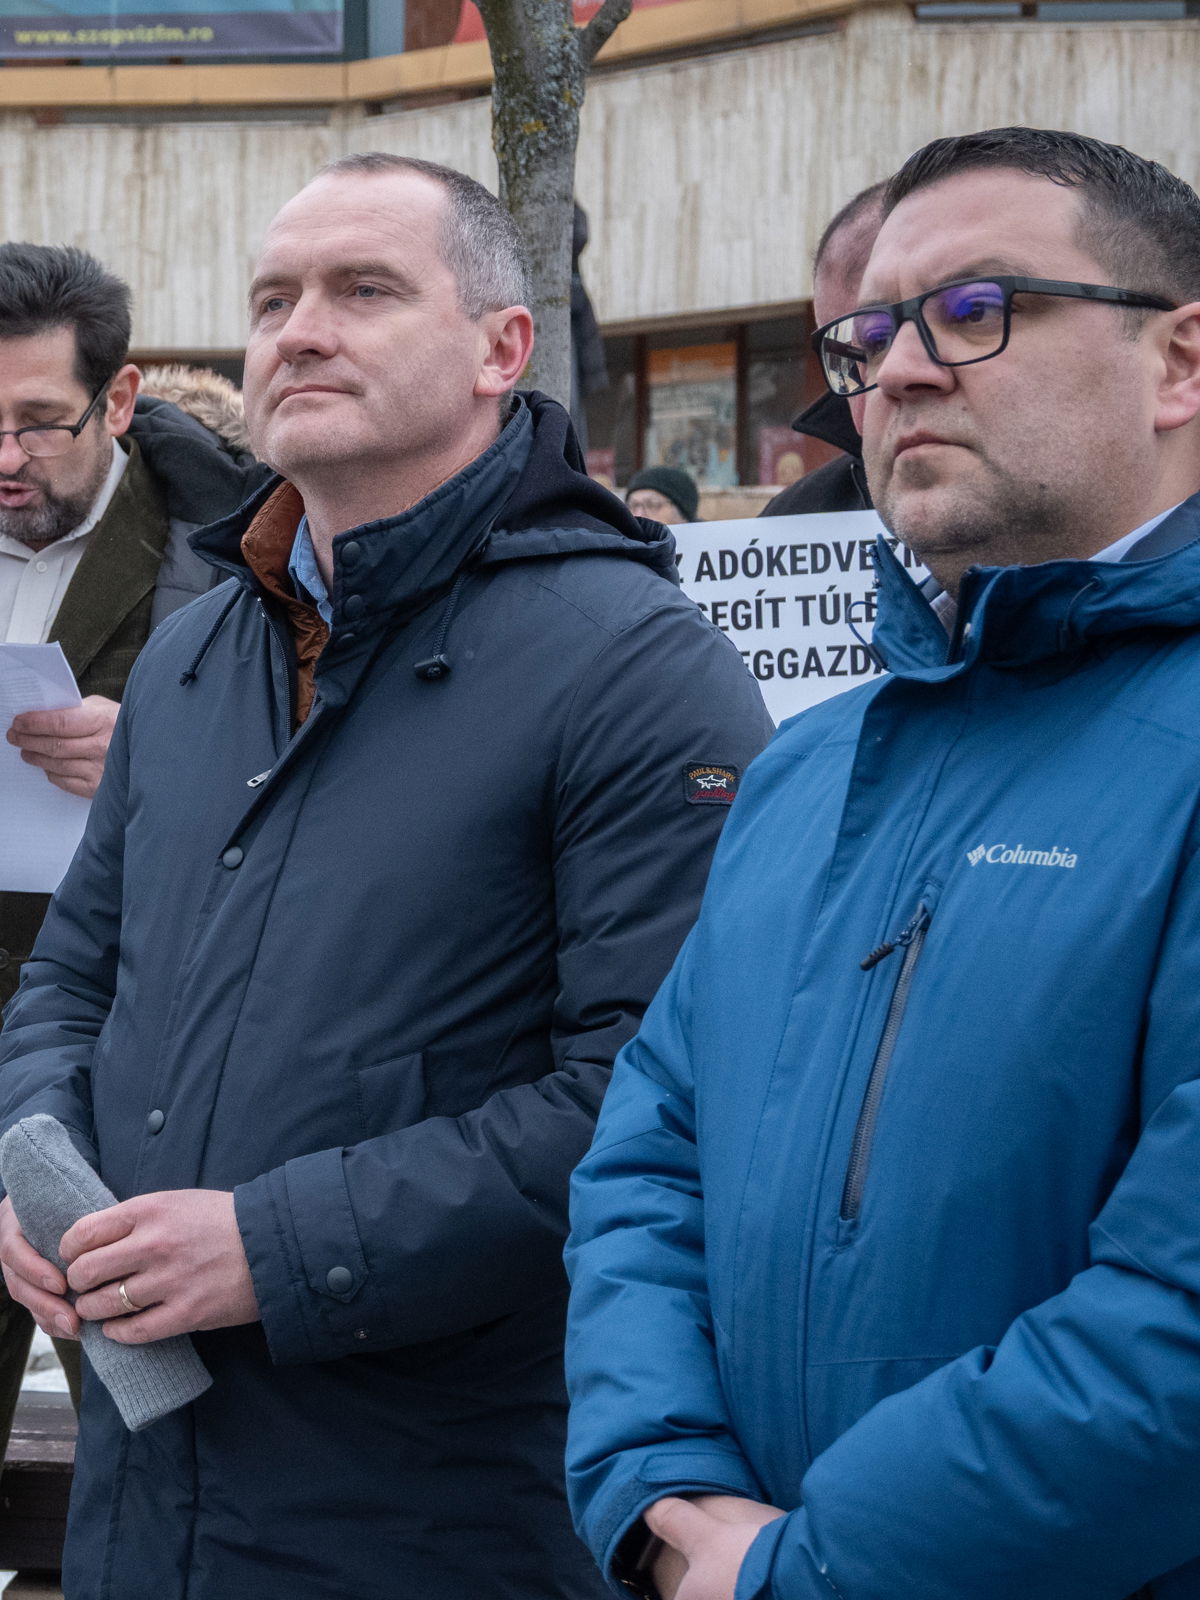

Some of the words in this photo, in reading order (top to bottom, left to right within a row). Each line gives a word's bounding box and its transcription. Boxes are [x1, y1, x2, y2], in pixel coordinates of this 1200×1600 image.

[697, 589, 787, 632] EGÍT
[741, 644, 883, 681] GGAZD
[985, 843, 1078, 868] Columbia
